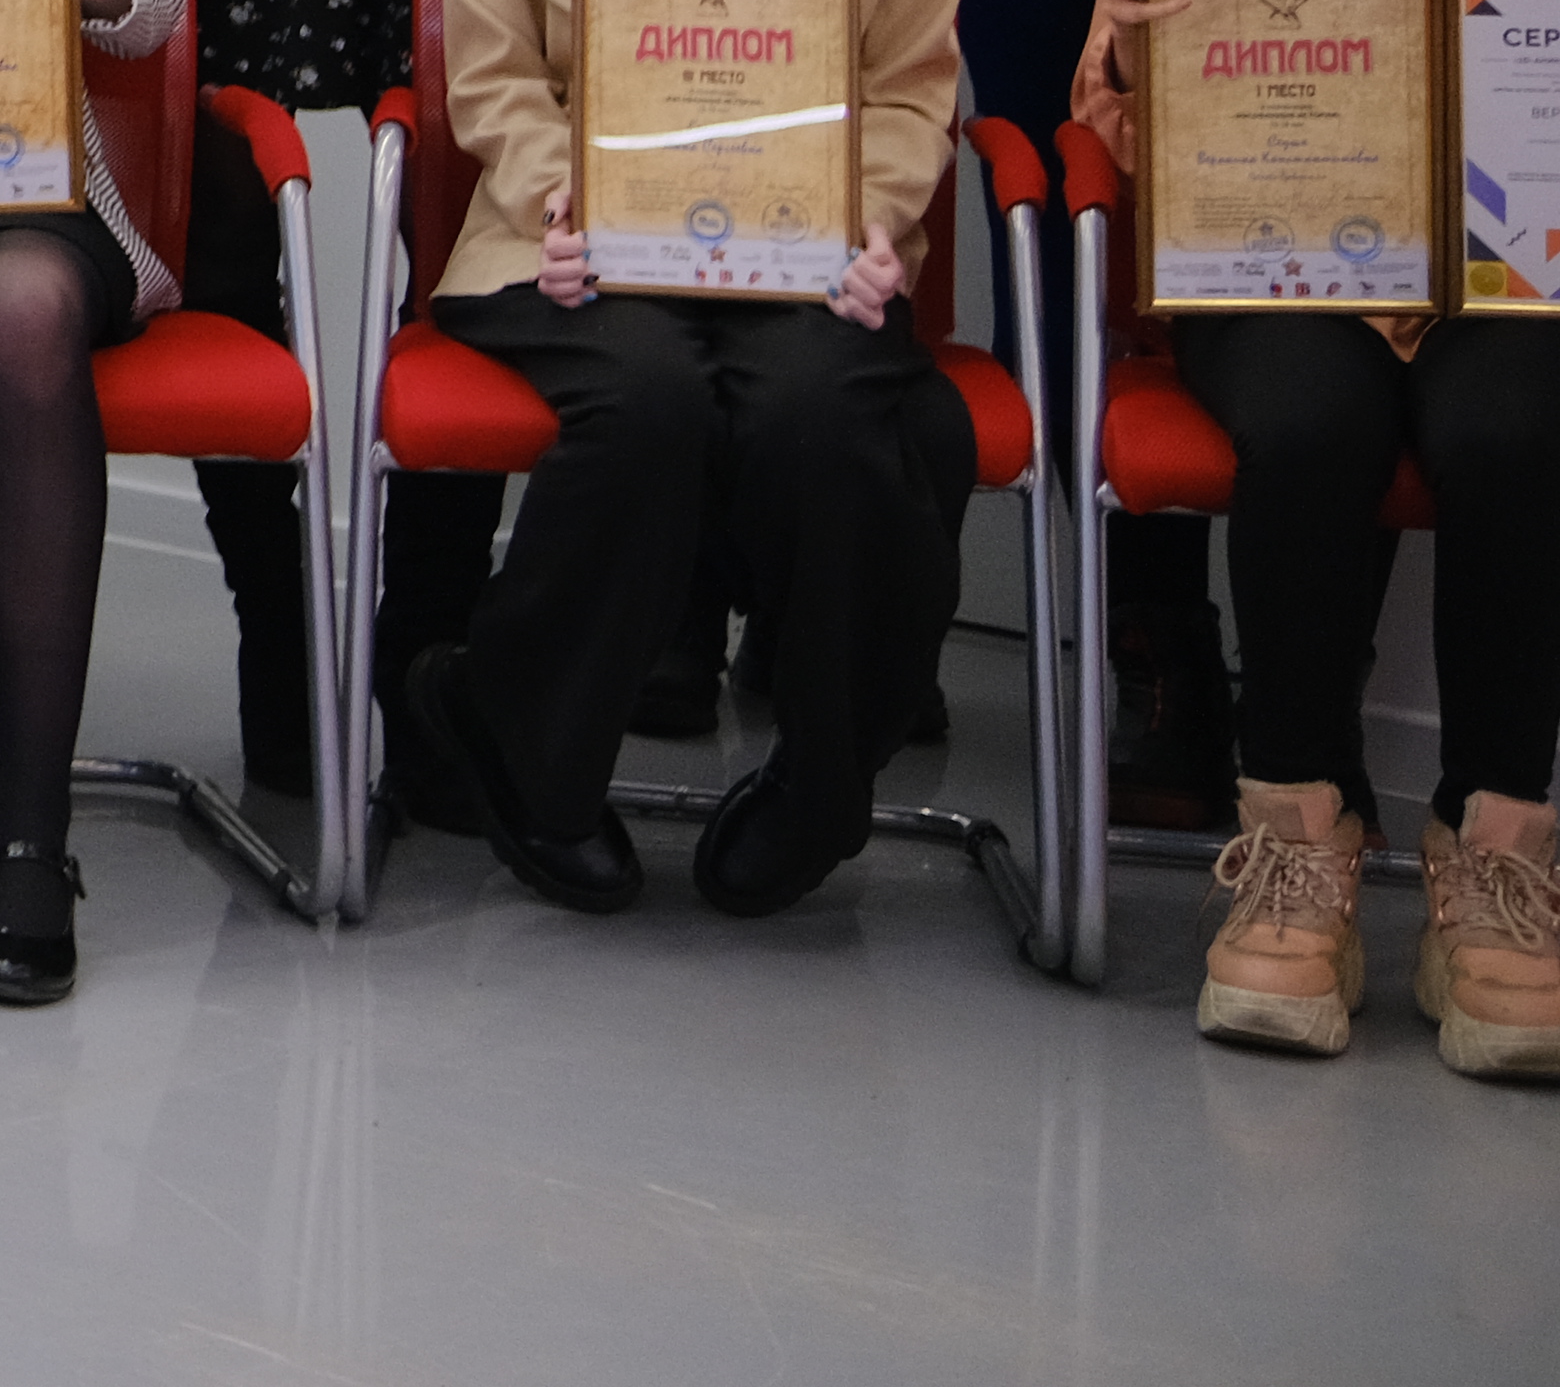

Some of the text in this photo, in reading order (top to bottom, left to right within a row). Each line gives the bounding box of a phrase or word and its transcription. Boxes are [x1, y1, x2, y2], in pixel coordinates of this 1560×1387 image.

[635, 24, 795, 65] ДИПЛОМ
[1203, 37, 1374, 79] ДИПЛОМ
[699, 68, 746, 86] МЕСТО
[1266, 83, 1317, 99] МЕСТО
